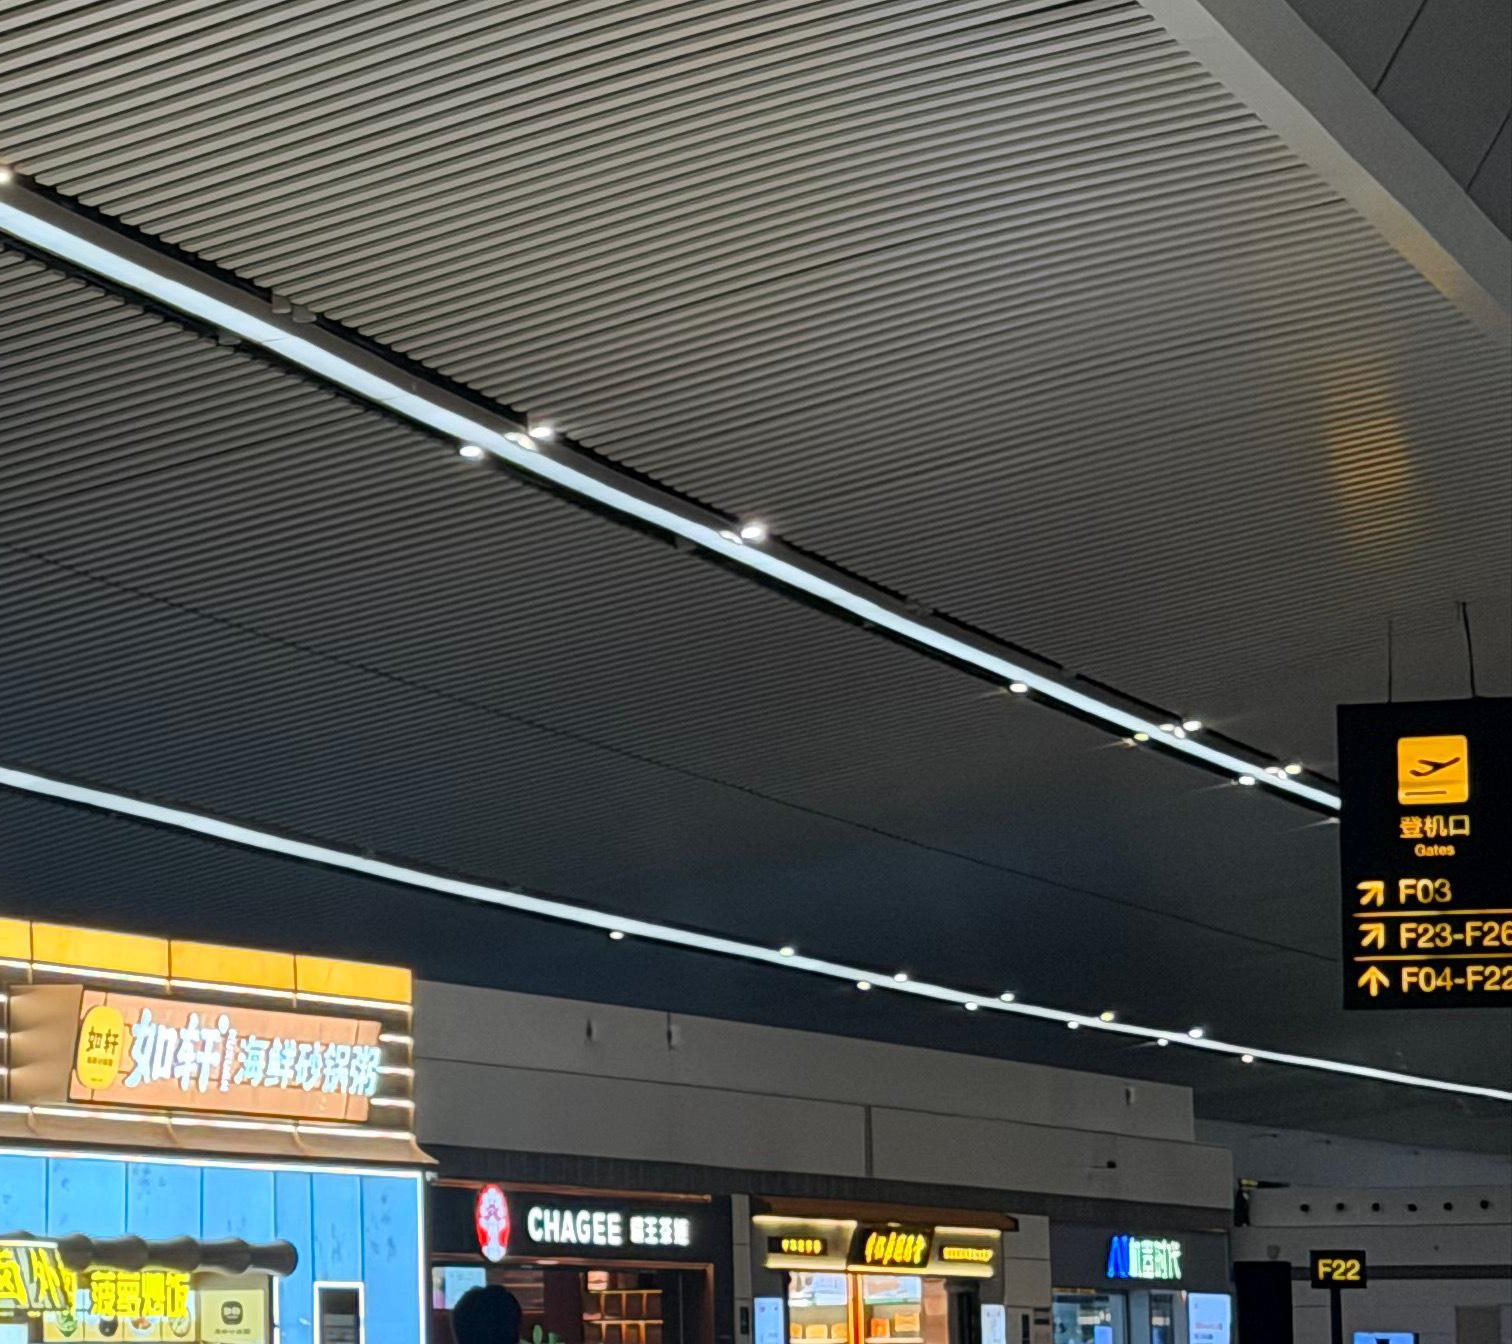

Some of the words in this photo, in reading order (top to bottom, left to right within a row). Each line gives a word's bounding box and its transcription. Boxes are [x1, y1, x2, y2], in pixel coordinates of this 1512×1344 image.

[1399, 815, 1471, 839] 登机口
[1414, 843, 1456, 857] Gates
[1399, 878, 1452, 904] F03
[1399, 920, 1512, 949] F23-F26
[1400, 965, 1512, 994] F04-F22
[122, 1008, 224, 1093] 如轩
[233, 1033, 382, 1098] 海鲜砂锅粥
[527, 1206, 624, 1246] CHAGEE
[1317, 1258, 1361, 1282] F22
